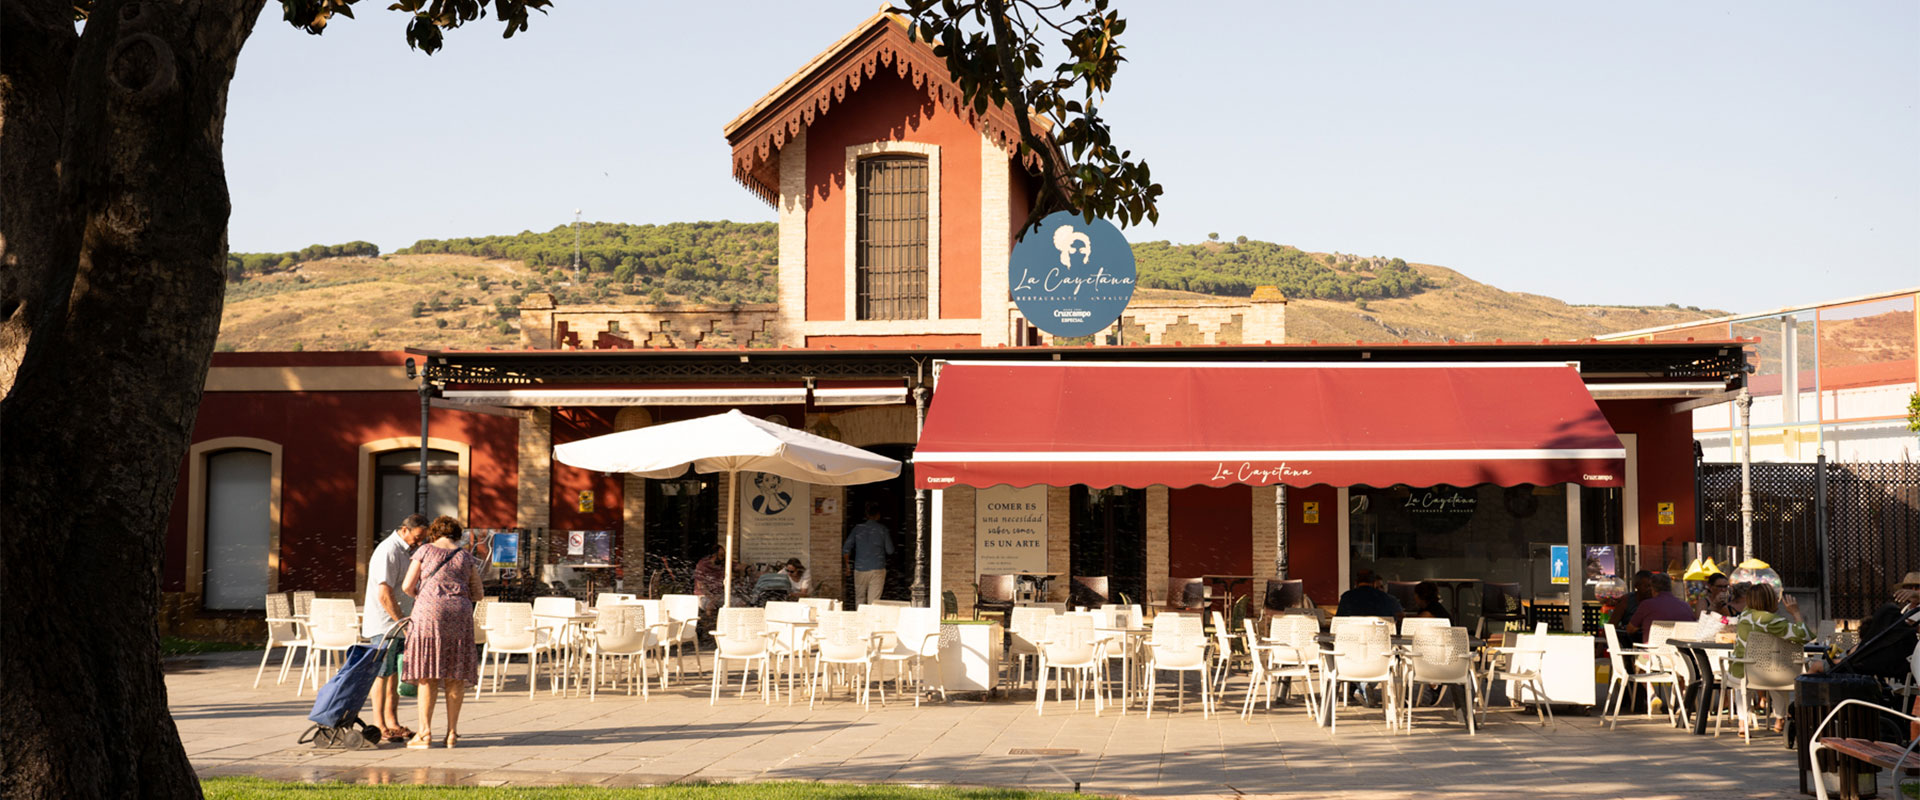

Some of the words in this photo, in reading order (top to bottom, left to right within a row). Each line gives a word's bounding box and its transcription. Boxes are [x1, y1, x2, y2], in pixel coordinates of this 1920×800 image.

[1014, 268, 1039, 292] La
[1044, 267, 1135, 295] Cayetana
[1053, 310, 1092, 318] Cruzcampo
[1211, 462, 1234, 481] La
[1238, 461, 1312, 484] Cayetana
[1583, 473, 1613, 481] Cruzcampo
[1404, 492, 1421, 508] La
[1422, 491, 1477, 510] Cayetana
[987, 502, 1022, 511] COMER
[1025, 502, 1037, 511] ES
[1002, 513, 1044, 523] necesidad
[988, 526, 1011, 535] saber
[984, 540, 995, 548] ES
[998, 540, 1013, 548] UN
[1015, 540, 1041, 548] ARTE
